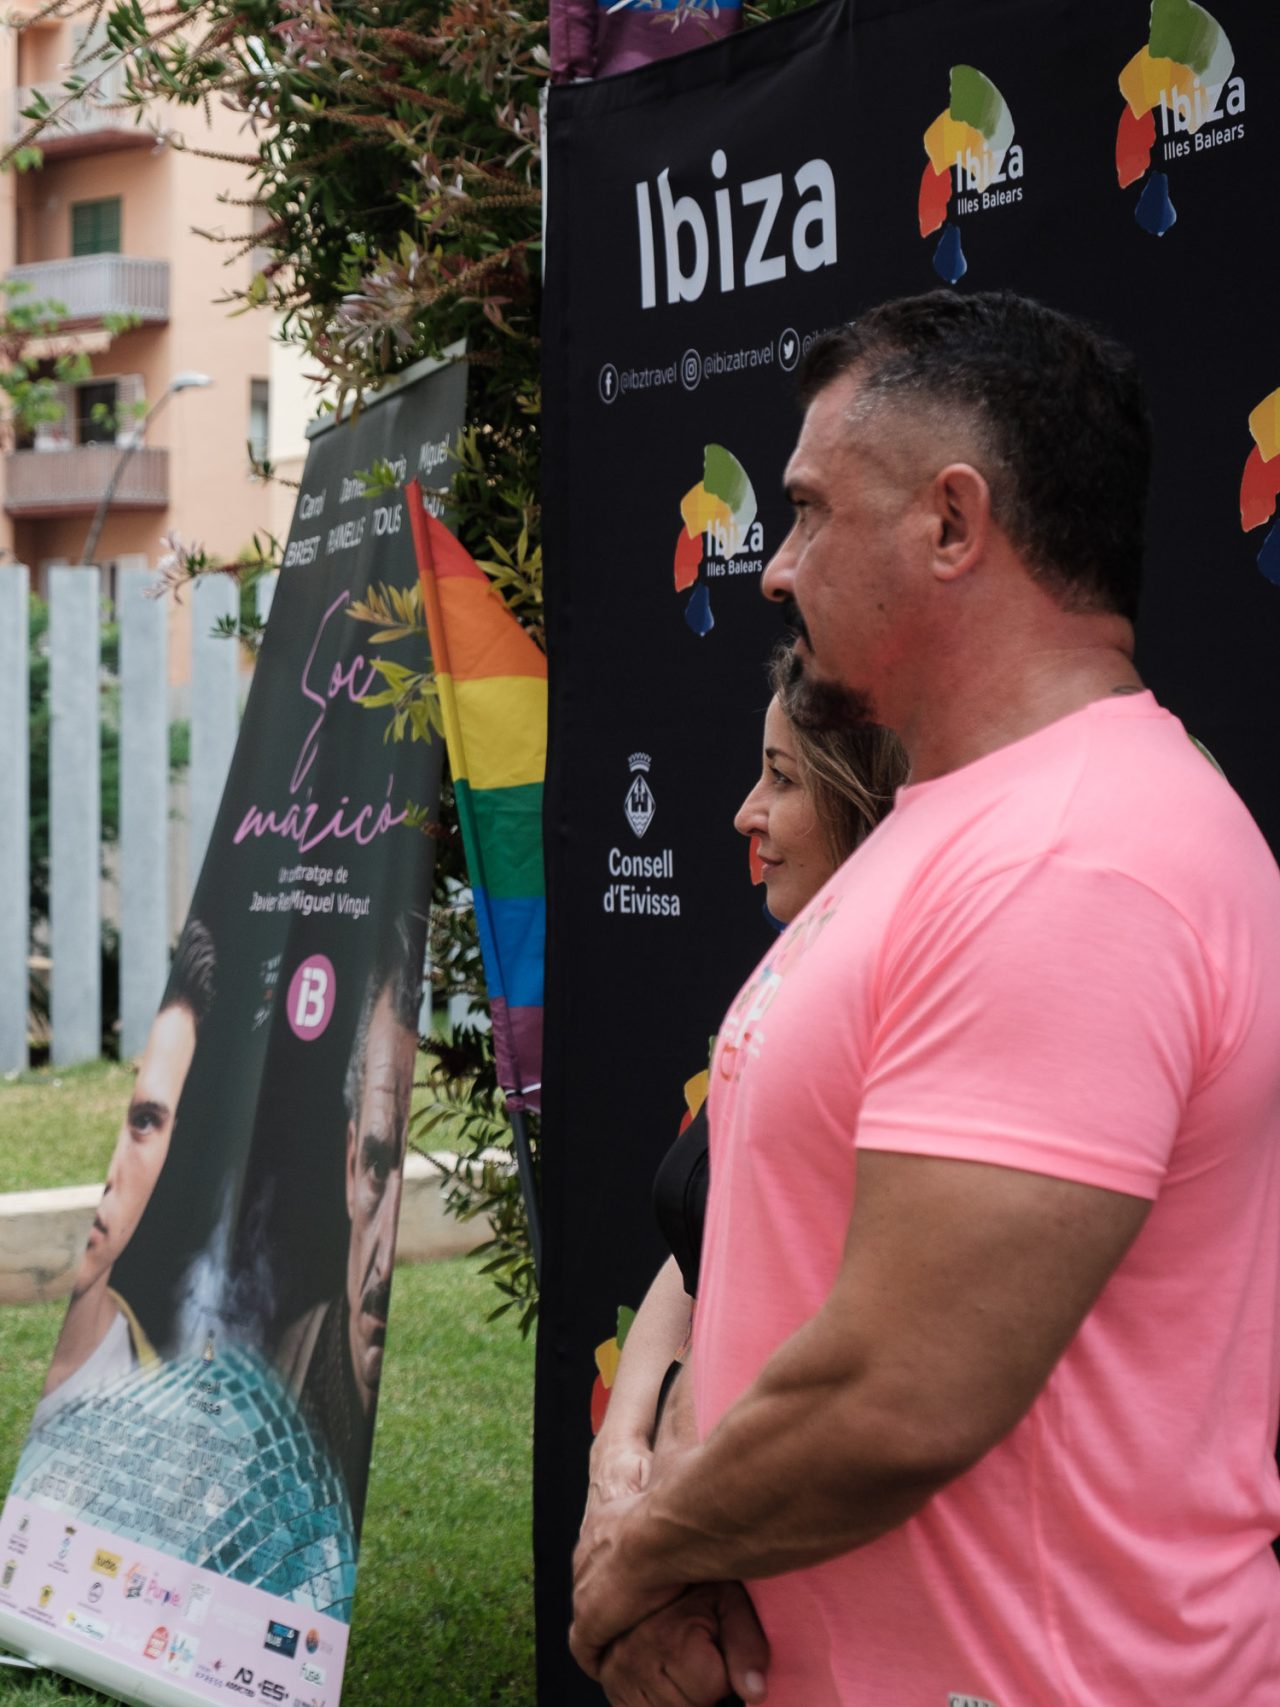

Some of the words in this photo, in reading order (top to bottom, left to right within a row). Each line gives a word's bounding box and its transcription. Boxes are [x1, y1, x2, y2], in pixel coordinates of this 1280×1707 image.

[1160, 73, 1246, 137] Ibiza
[1163, 140, 1191, 161] Illes
[1194, 123, 1245, 152] Balears
[956, 142, 1024, 193] Ibiza
[957, 197, 980, 216] Illes
[982, 187, 1023, 210] Balears
[636, 149, 838, 310] Ibiza
[703, 341, 774, 379] @ibizatravel
[372, 503, 403, 536] TOUS
[706, 515, 764, 558] Ibiza
[706, 561, 726, 577] Illes
[728, 559, 763, 576] Balears
[334, 865, 349, 884] de
[608, 846, 674, 879] Consell
[337, 893, 371, 920] Vingut
[603, 883, 681, 917] d'Eivissa
